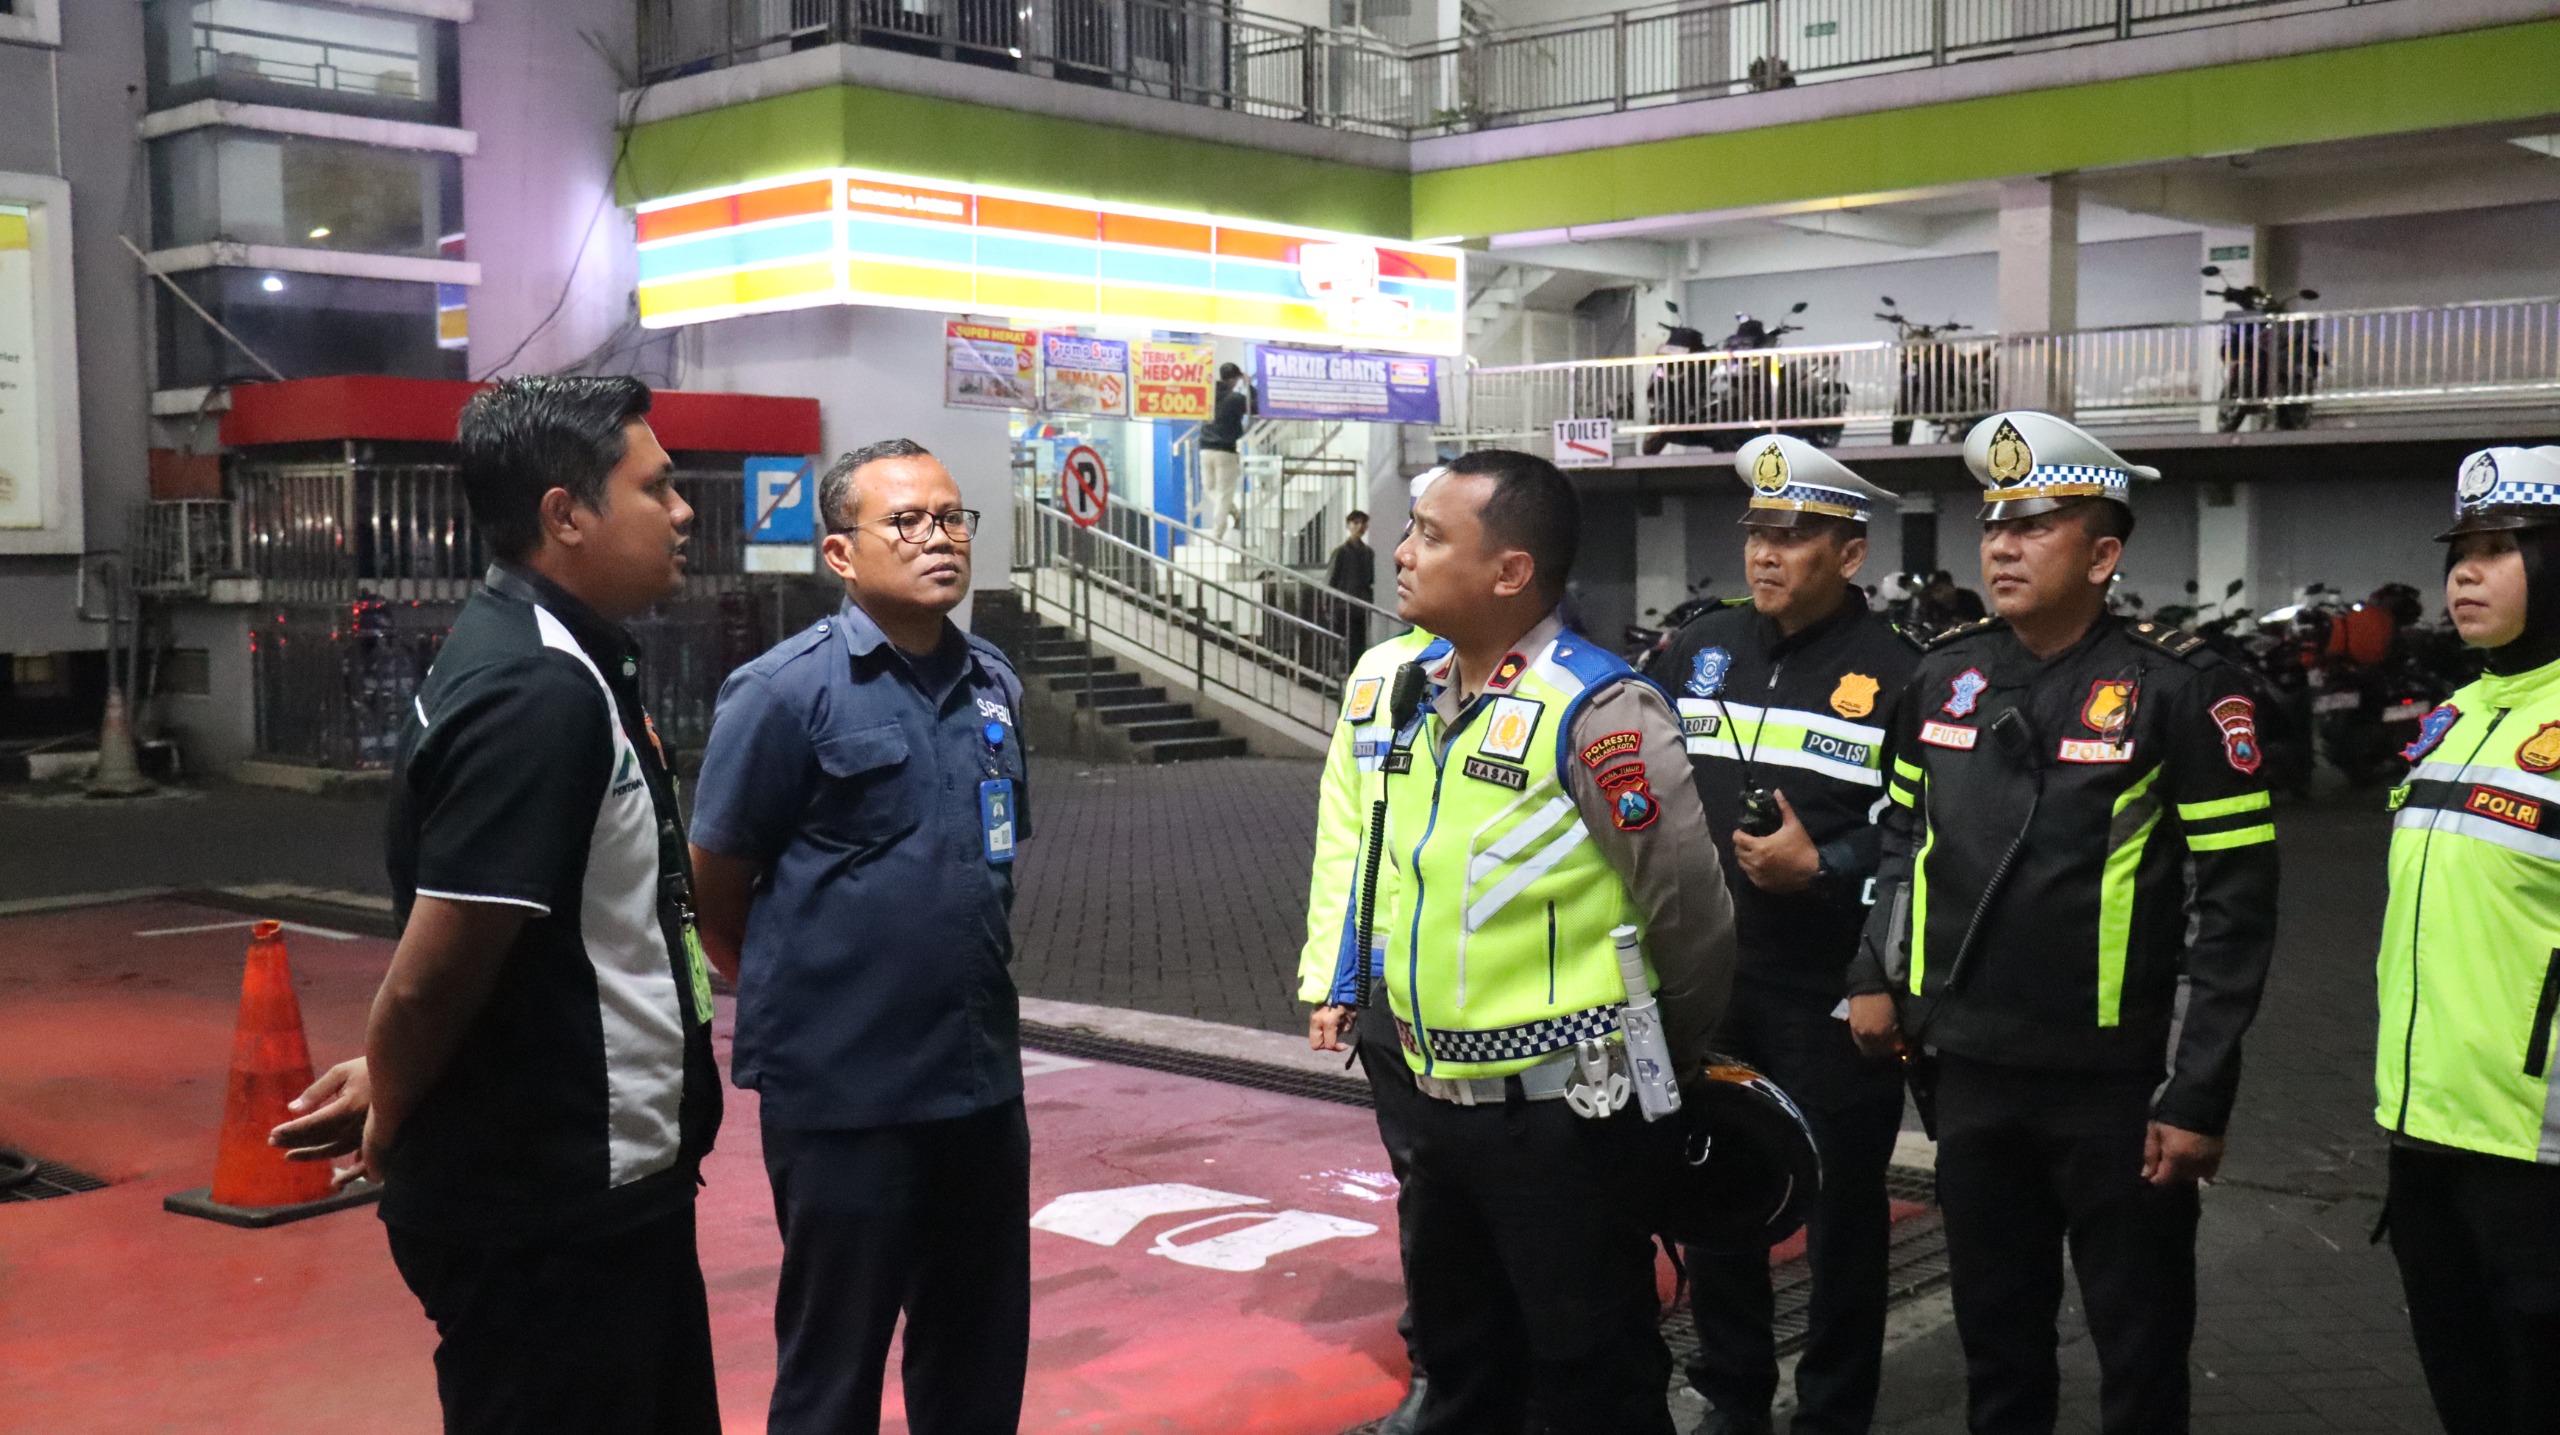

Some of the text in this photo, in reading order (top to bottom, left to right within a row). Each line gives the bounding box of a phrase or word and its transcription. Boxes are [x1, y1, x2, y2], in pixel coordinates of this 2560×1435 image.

[957, 325, 1026, 345] SUPER HEMAT
[1050, 339, 1090, 358] Promo
[1093, 342, 1121, 359] Susu
[1143, 351, 1176, 363] TEBUS
[1143, 364, 1204, 383] HEBOH!
[1265, 352, 1387, 382] PARKIR GRATIS
[1558, 421, 1608, 440] TOILET
[976, 698, 1012, 726] SPBU
[1929, 726, 1969, 745] FUTO
[1585, 734, 1636, 760] POLRESTA
[1591, 742, 1634, 763] MALANG KOTA
[1808, 733, 1868, 763] POLISI
[2066, 742, 2126, 760] POLRI
[1470, 762, 1519, 785] KASAT
[1601, 770, 1618, 784] JAWA
[2473, 792, 2538, 824] POLRI
